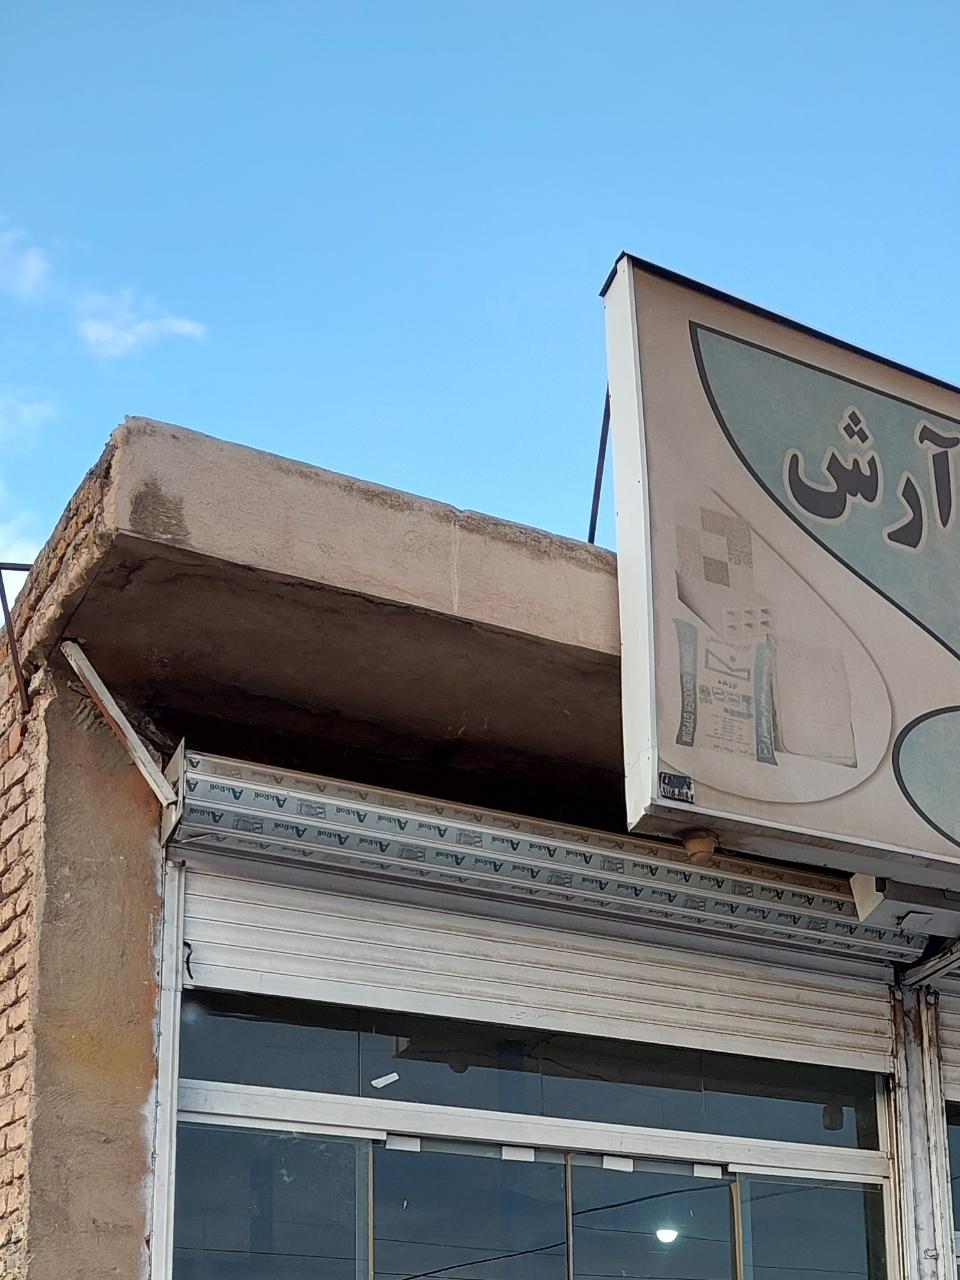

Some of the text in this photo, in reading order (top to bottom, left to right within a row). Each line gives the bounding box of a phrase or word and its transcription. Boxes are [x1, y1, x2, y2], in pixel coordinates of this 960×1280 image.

[785, 409, 960, 549] آرش
[209, 783, 243, 800] AkRoll
[188, 807, 224, 824] AkRoll
